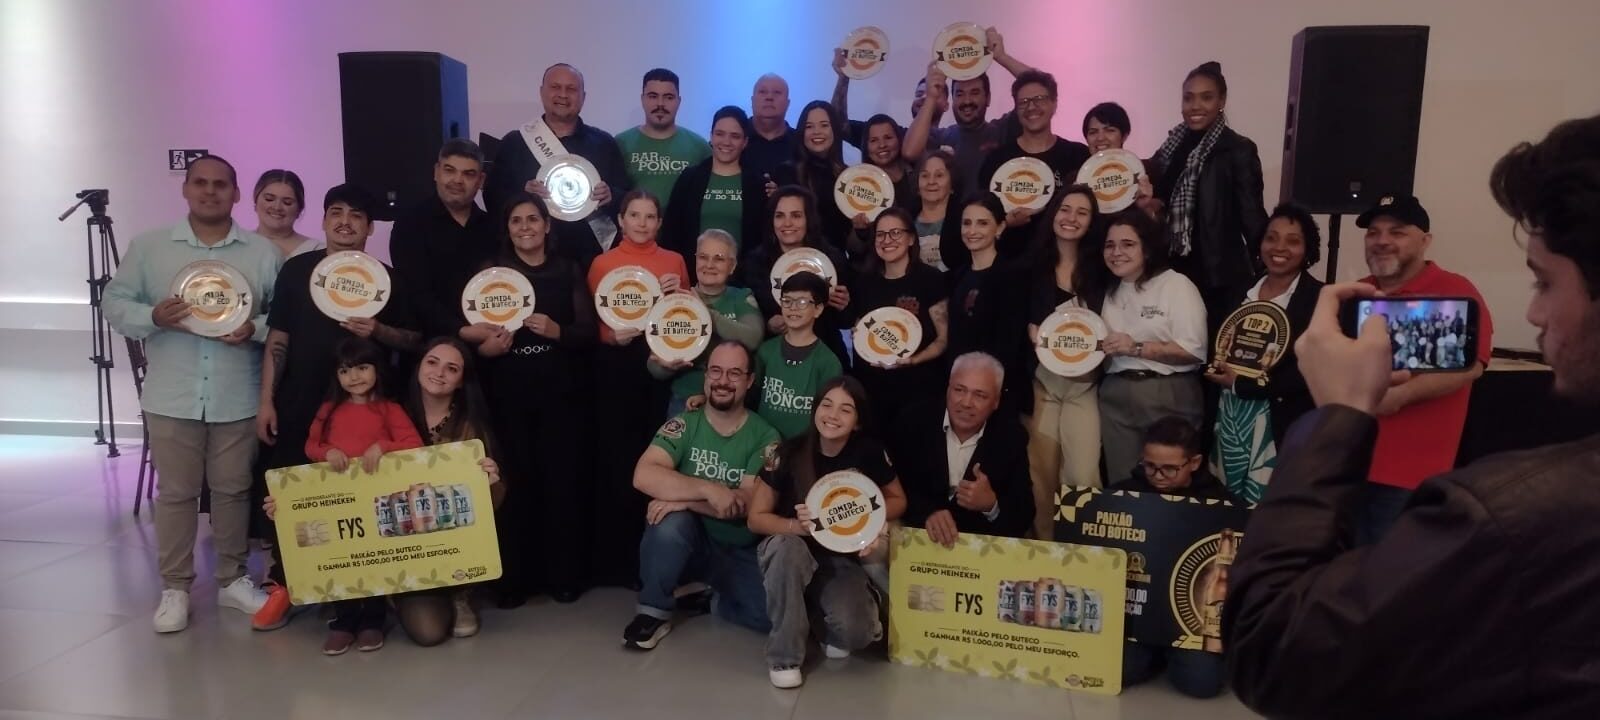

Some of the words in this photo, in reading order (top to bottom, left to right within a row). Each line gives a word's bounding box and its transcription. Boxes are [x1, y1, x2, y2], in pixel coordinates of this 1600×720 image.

[535, 136, 555, 158] CAM
[631, 152, 659, 163] BAR
[638, 160, 689, 171] PONCE
[336, 277, 365, 289] COMIDA
[341, 286, 369, 297] BUTECO
[484, 294, 512, 302] COMIDA
[1247, 317, 1262, 330] TOP
[1262, 320, 1270, 331] 2
[765, 390, 814, 410] PONCE
[689, 447, 719, 466] BAR
[292, 501, 319, 511] GRUPO
[319, 496, 356, 507] HEINEKEN
[416, 498, 431, 511] FYS
[828, 500, 858, 515] COMIDA
[837, 505, 865, 519] BUTECO
[1096, 511, 1133, 527] PAIXÃO
[337, 517, 366, 540] FYS
[1082, 522, 1107, 538] PELO
[1107, 525, 1146, 543] BOTECO
[377, 548, 395, 557] PELO
[395, 545, 422, 555] BUTECO
[323, 562, 351, 571] GANHAR
[392, 554, 409, 563] PELO
[410, 552, 425, 560] MEU
[910, 565, 939, 575] GRUPO
[940, 569, 980, 580] HEINEKEN
[955, 592, 983, 616] FYS
[1042, 593, 1058, 607] FYS
[930, 632, 960, 642] GANHAR
[1005, 642, 1024, 651] PELO
[962, 628, 989, 638] PAIXÃO
[991, 632, 1009, 641] PELO
[1011, 635, 1040, 645] BUTECO
